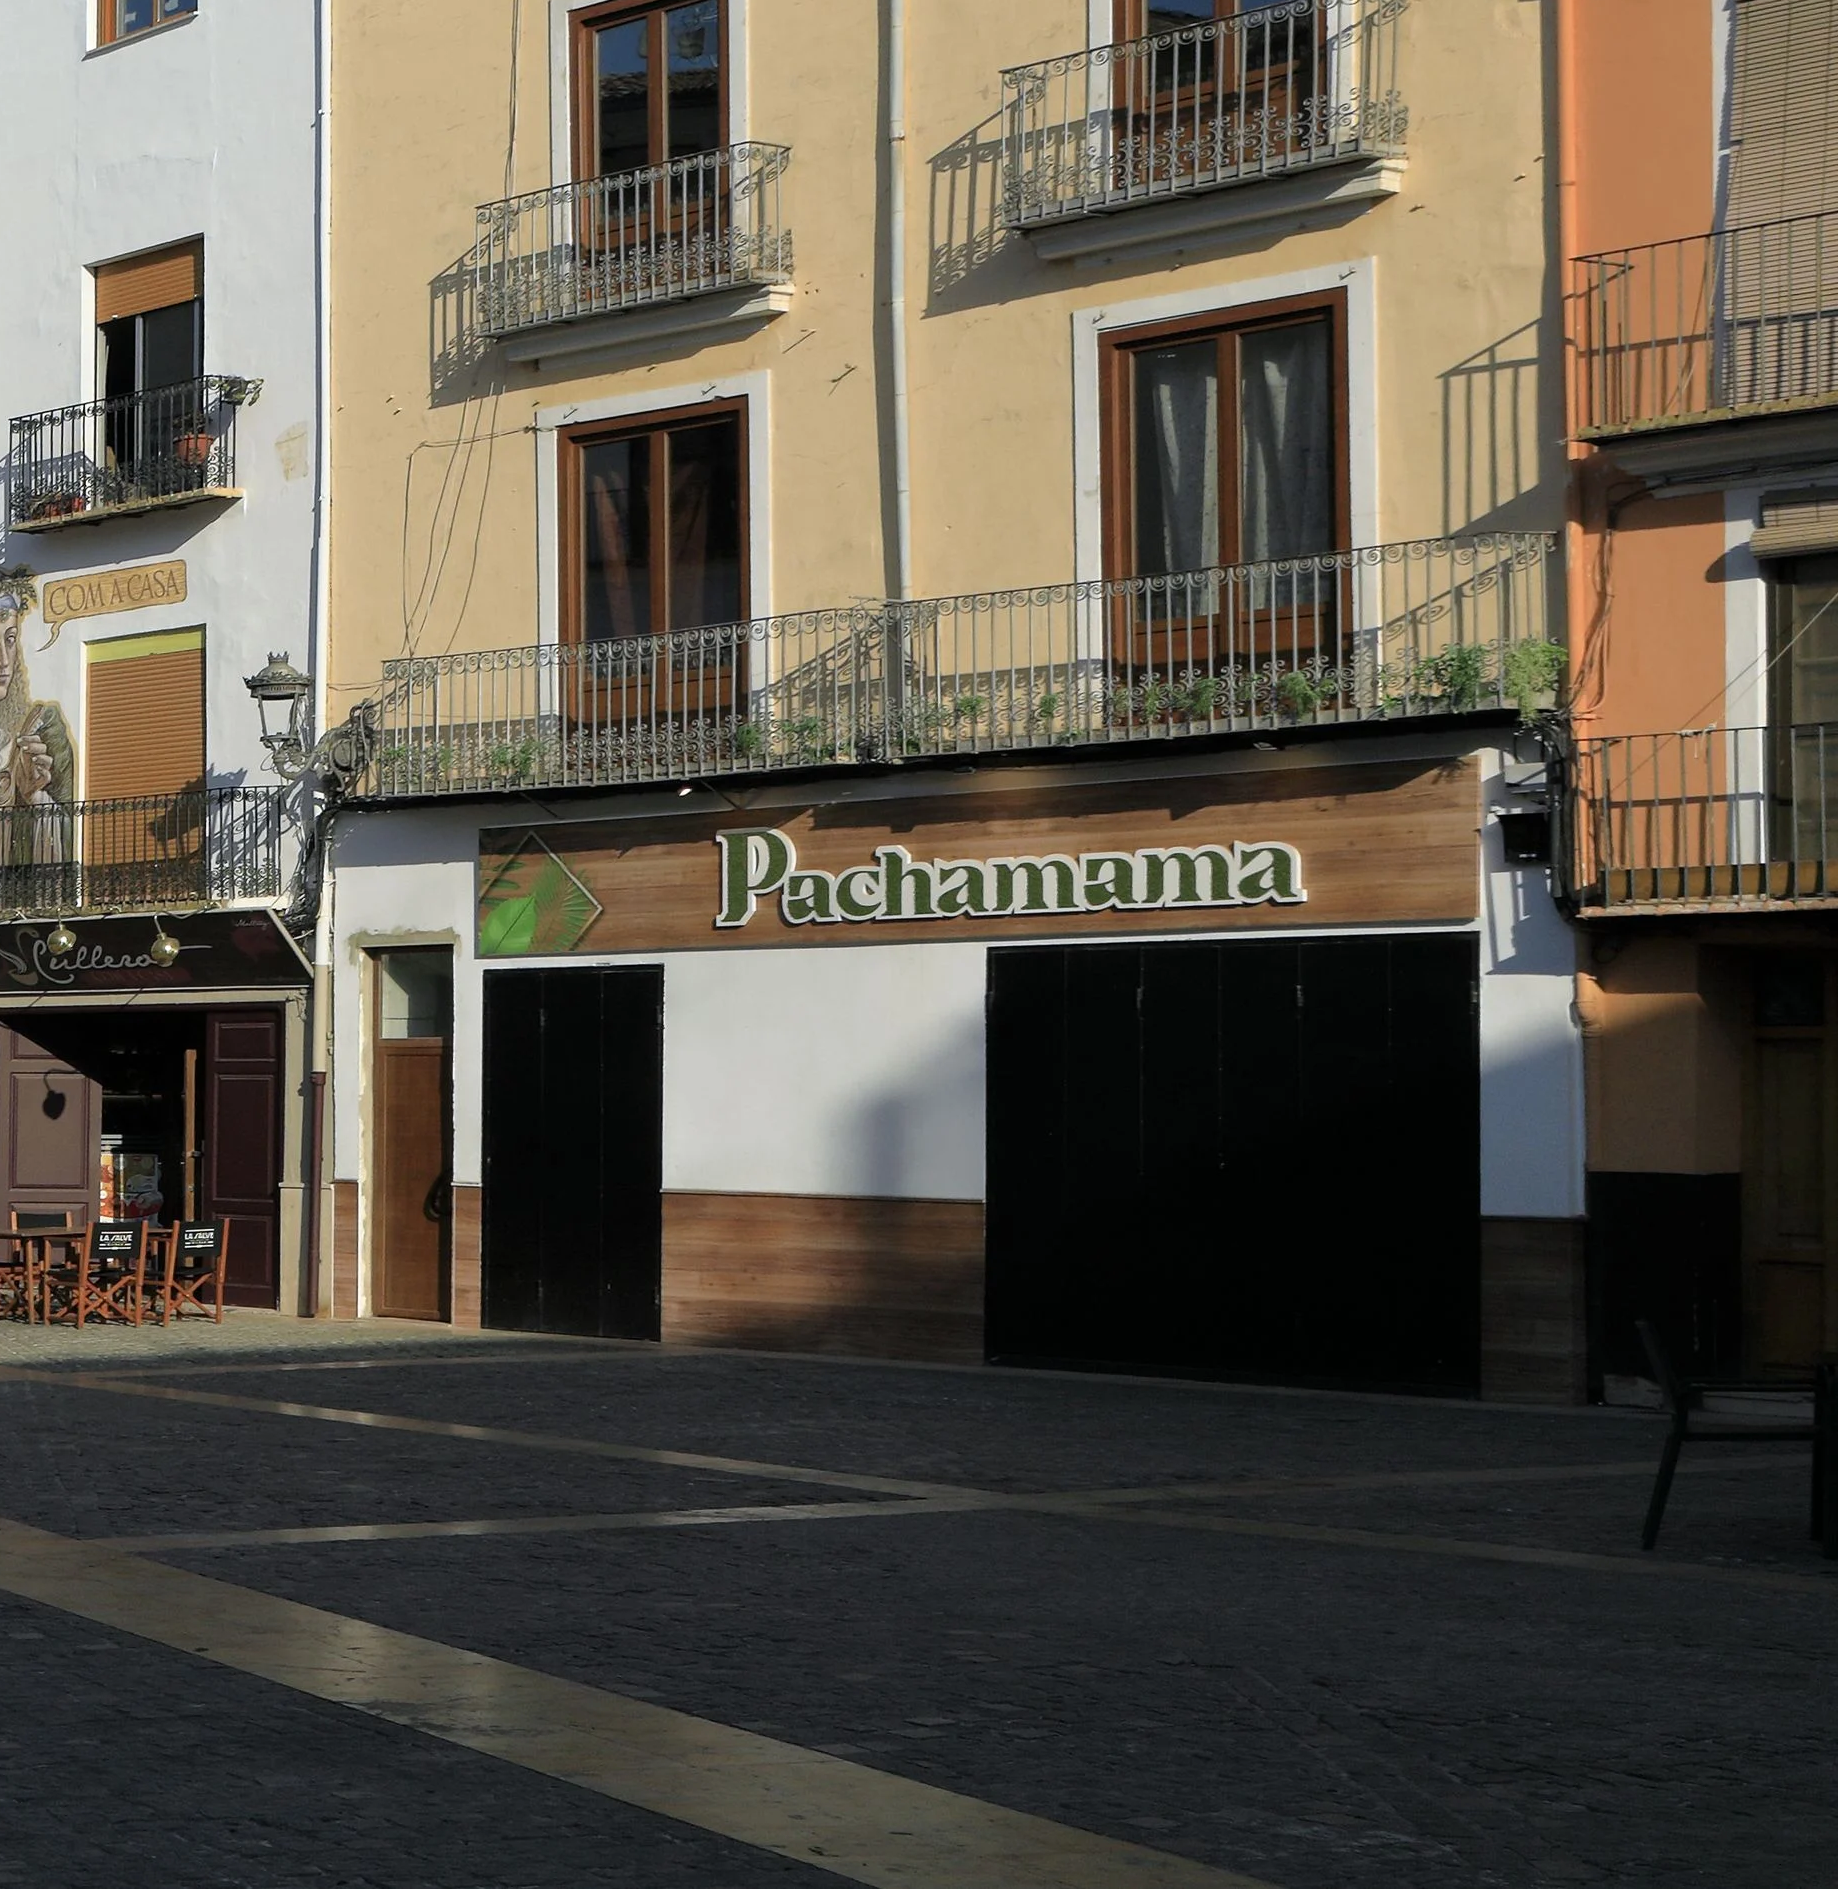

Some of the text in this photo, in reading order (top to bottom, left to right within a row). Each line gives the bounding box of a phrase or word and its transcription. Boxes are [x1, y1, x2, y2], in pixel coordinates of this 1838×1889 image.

[49, 568, 181, 616] COM A CASA
[716, 827, 1308, 927] Pachamama
[99, 1233, 133, 1242] LA SALVE
[184, 1232, 194, 1241] LA
